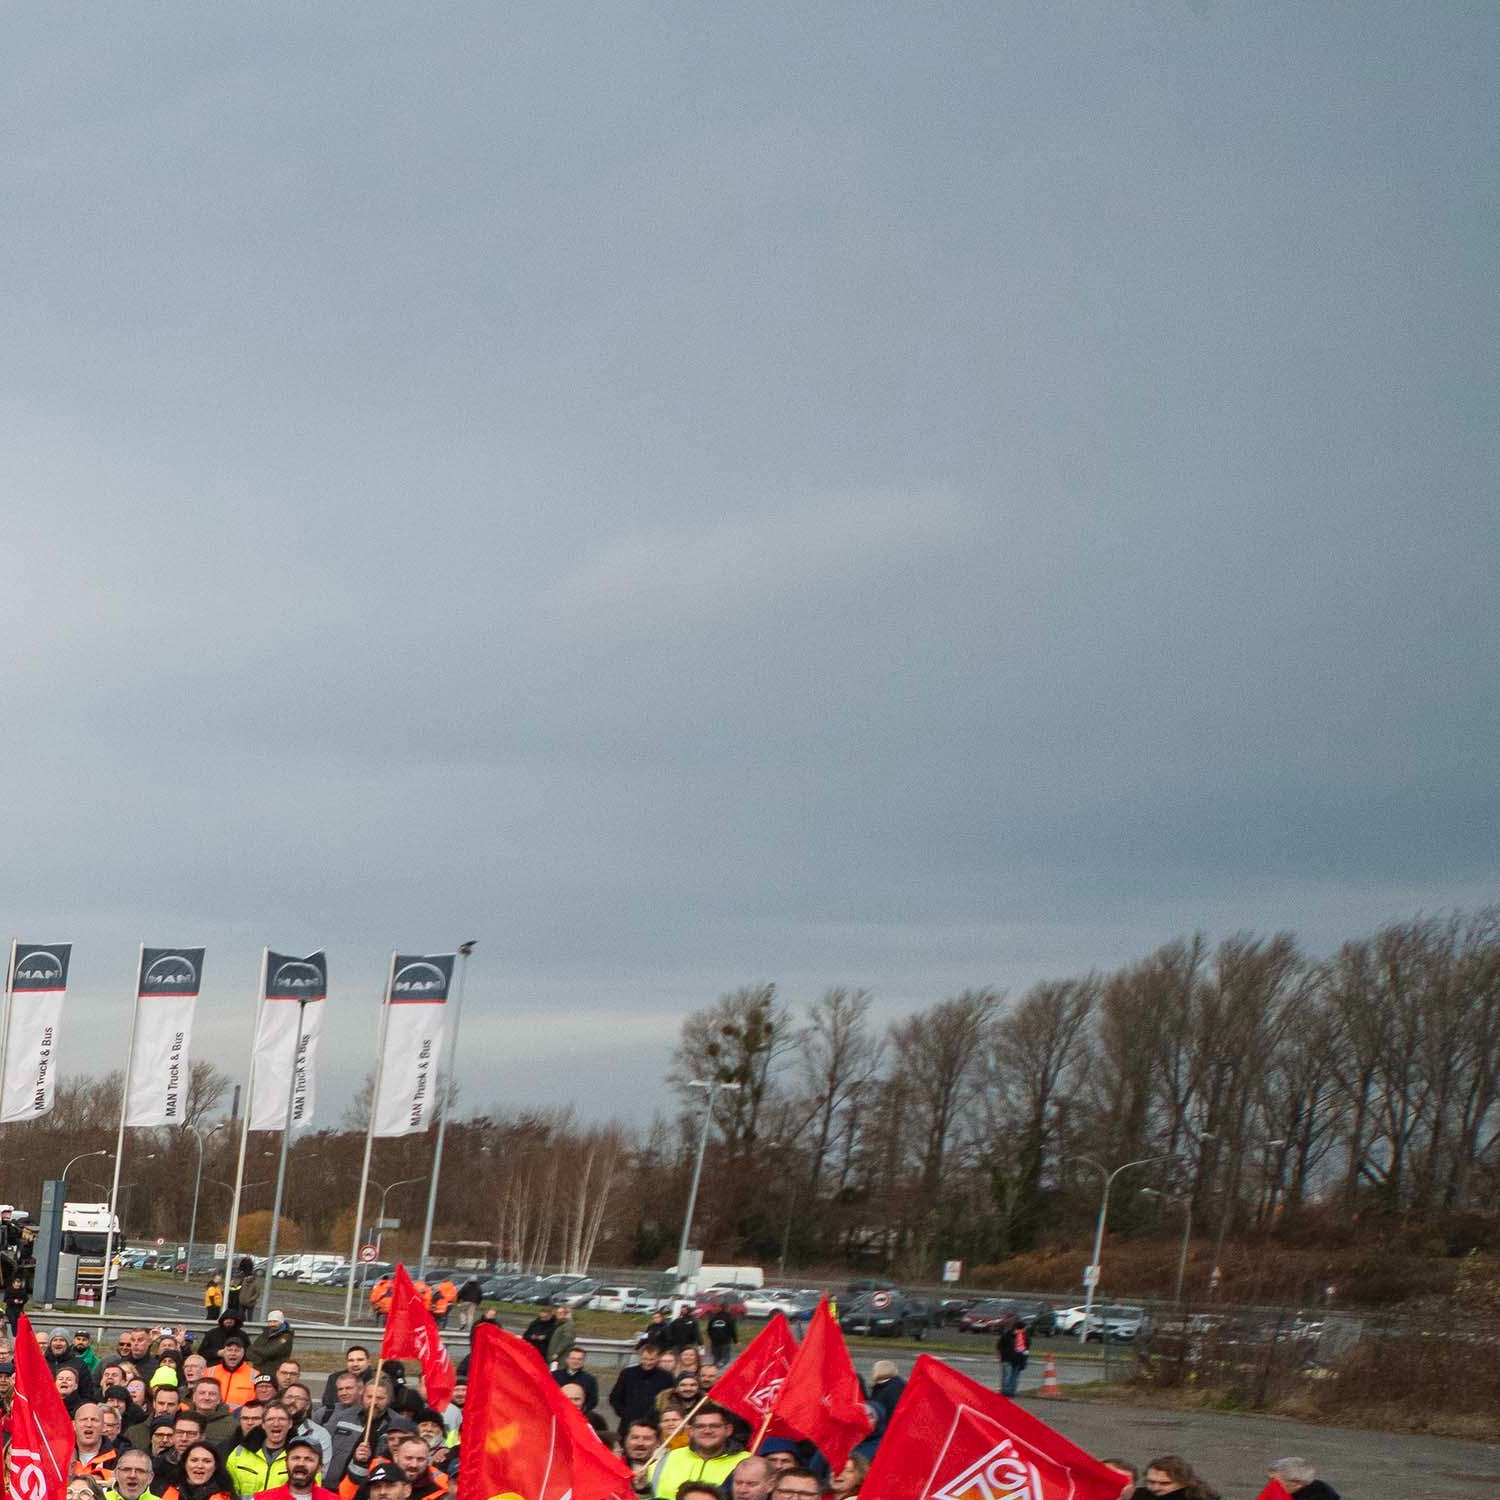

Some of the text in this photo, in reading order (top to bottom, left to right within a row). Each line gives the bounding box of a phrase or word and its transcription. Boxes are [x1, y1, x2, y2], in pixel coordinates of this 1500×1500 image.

[419, 1040, 432, 1060] Bus
[35, 1027, 53, 1110] MAN Truck & Bus
[166, 1032, 184, 1116] MAN Truck & Bus
[414, 1073, 427, 1100] Truck
[294, 1098, 304, 1120] MAN
[411, 1104, 422, 1126] MAN
